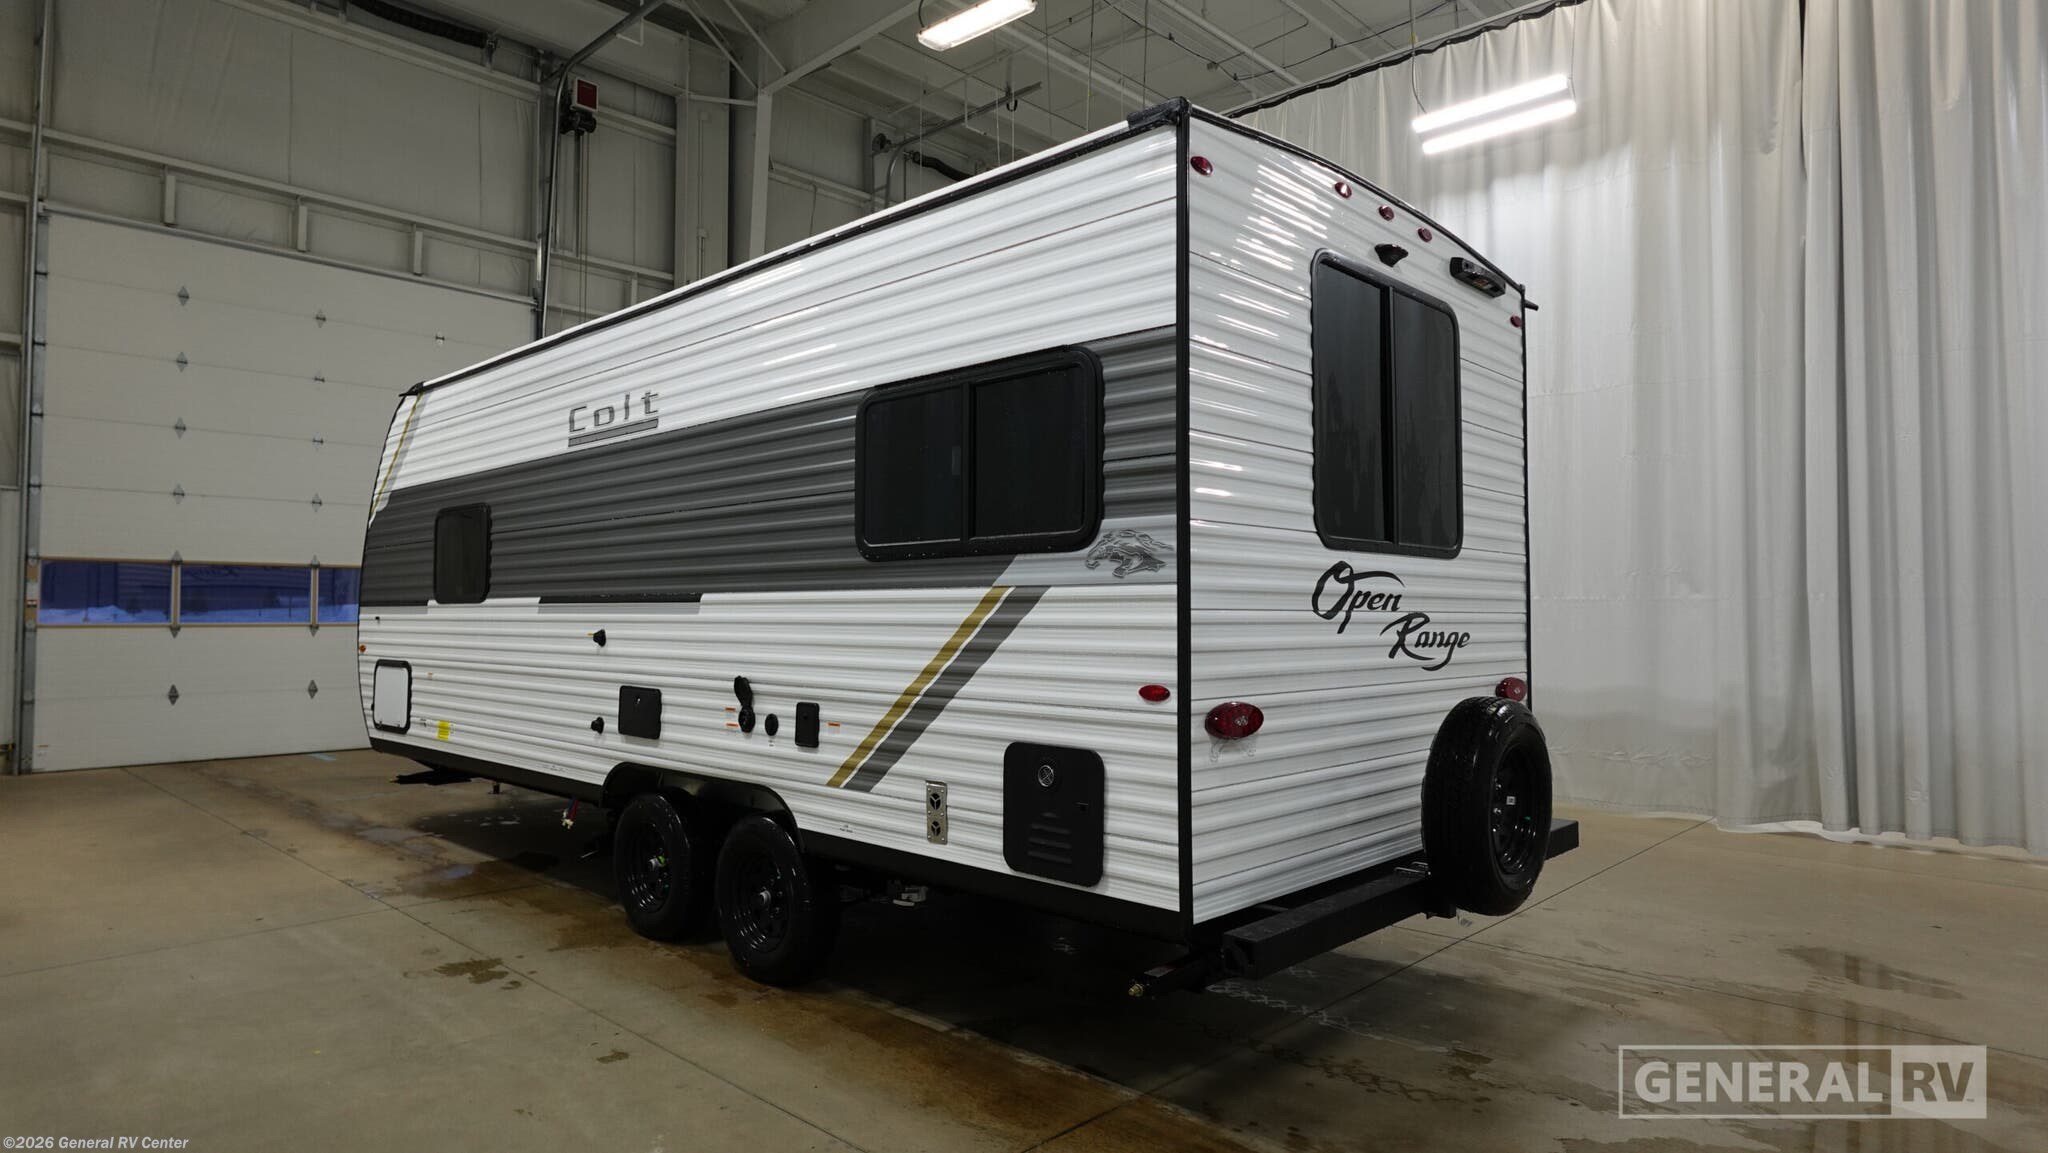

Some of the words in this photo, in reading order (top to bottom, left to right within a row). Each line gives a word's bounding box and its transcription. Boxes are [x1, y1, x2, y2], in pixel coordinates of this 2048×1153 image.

[568, 391, 659, 433] Colt
[1311, 560, 1406, 634] Open
[1379, 612, 1471, 671] Range
